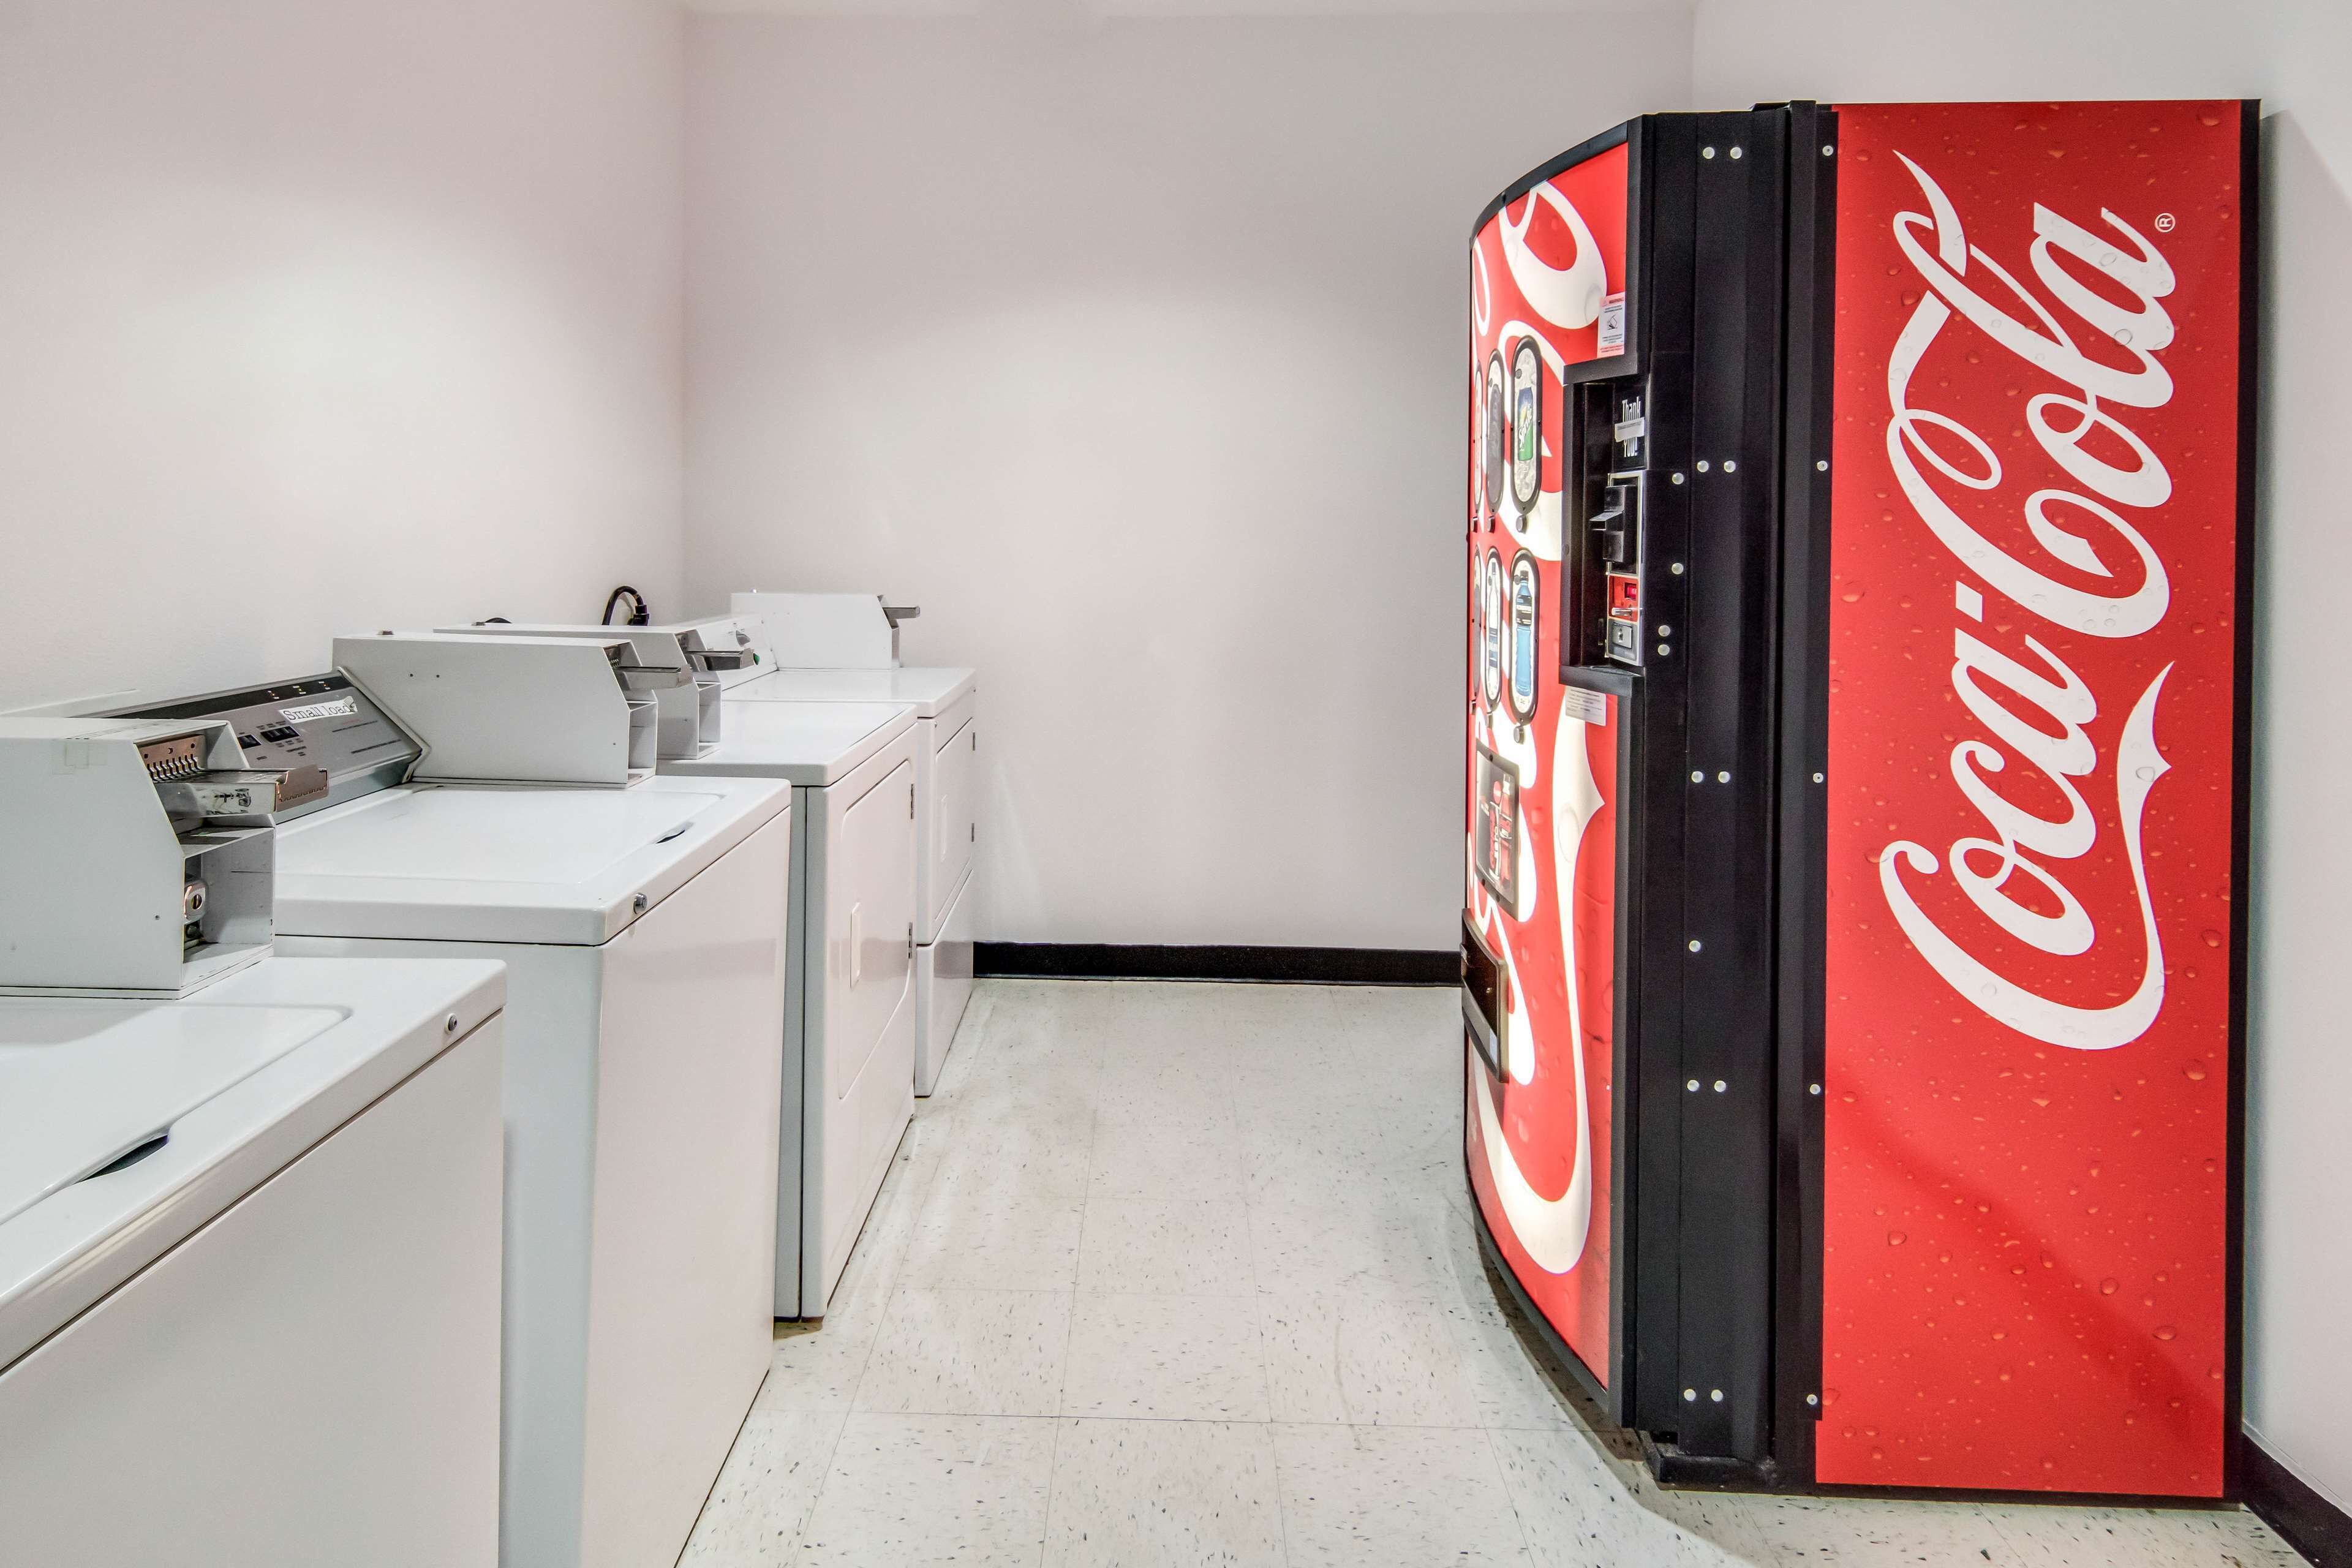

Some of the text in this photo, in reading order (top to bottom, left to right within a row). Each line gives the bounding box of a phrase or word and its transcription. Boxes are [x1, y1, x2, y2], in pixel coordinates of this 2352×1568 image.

[1622, 396, 1642, 423] Thank
[1879, 149, 2176, 1050] Coca-Cola
[283, 707, 325, 720] Small
